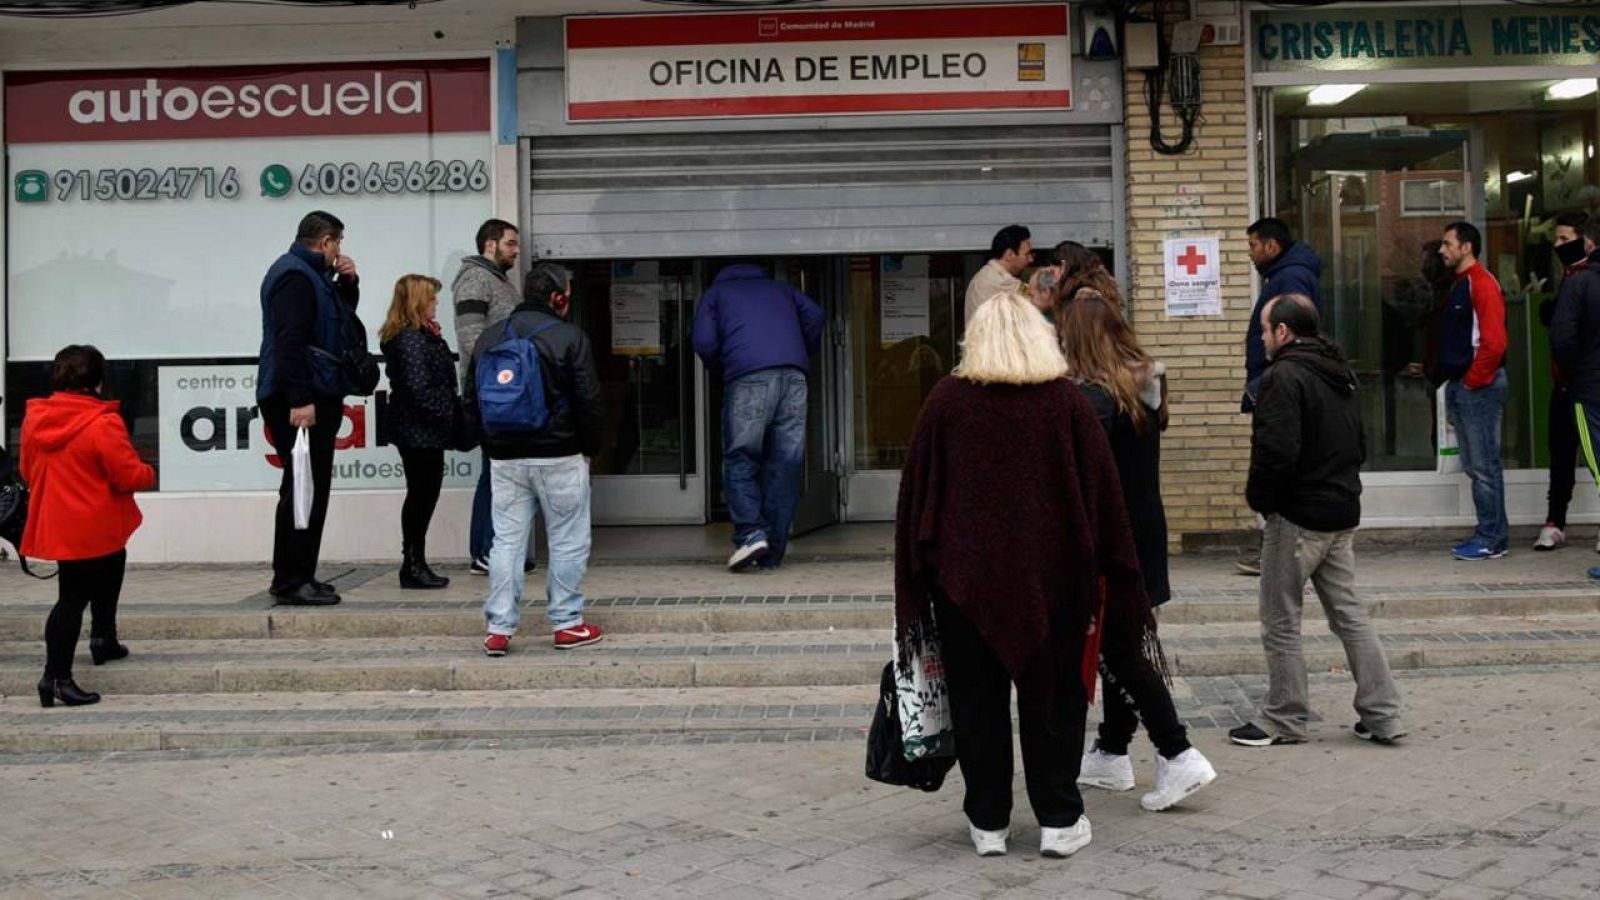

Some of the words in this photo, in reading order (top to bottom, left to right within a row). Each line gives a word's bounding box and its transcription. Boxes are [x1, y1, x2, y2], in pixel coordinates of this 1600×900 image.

[780, 22, 829, 30] Comunidad
[844, 20, 875, 28] Madrid
[1258, 16, 1471, 60] CRISTALERIA
[649, 58, 784, 86] OFICINA
[795, 55, 838, 81] DE
[850, 52, 987, 80] EMPLEO
[68, 71, 424, 124] autoescuela
[54, 167, 241, 201] 915024716
[299, 160, 488, 195] 608656286
[177, 377, 236, 390] centro
[330, 458, 472, 478] utoesela
